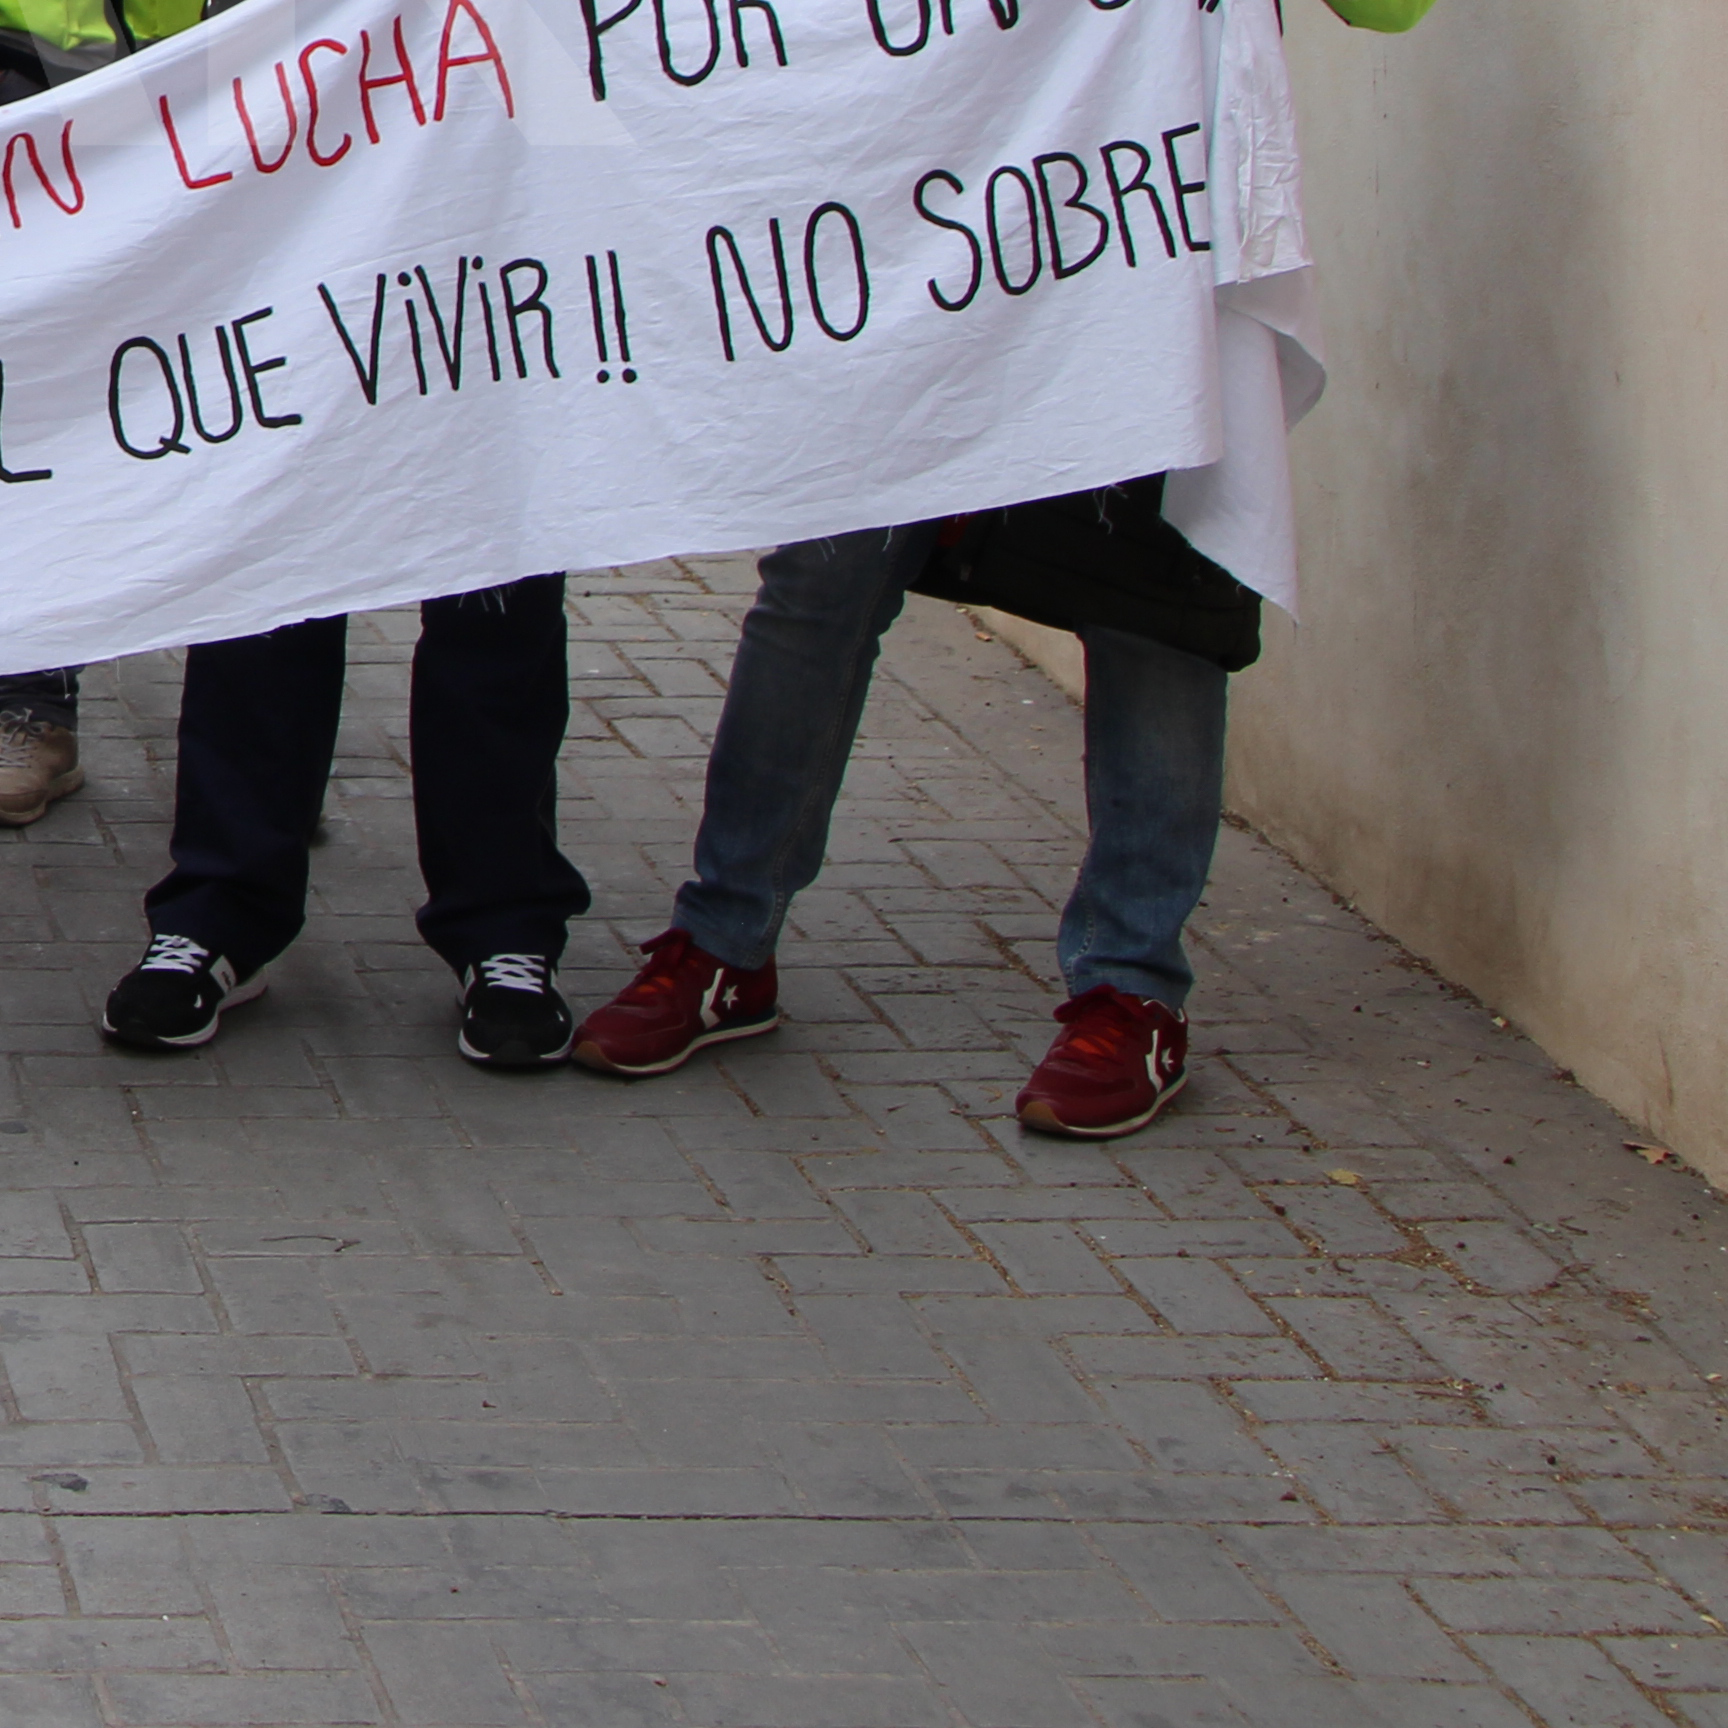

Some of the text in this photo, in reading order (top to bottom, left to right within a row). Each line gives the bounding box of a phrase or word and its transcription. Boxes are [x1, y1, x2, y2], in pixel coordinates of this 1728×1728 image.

[109, 306, 303, 459] QUE
[706, 201, 869, 362] NO
[913, 122, 1212, 312] SOBRE
